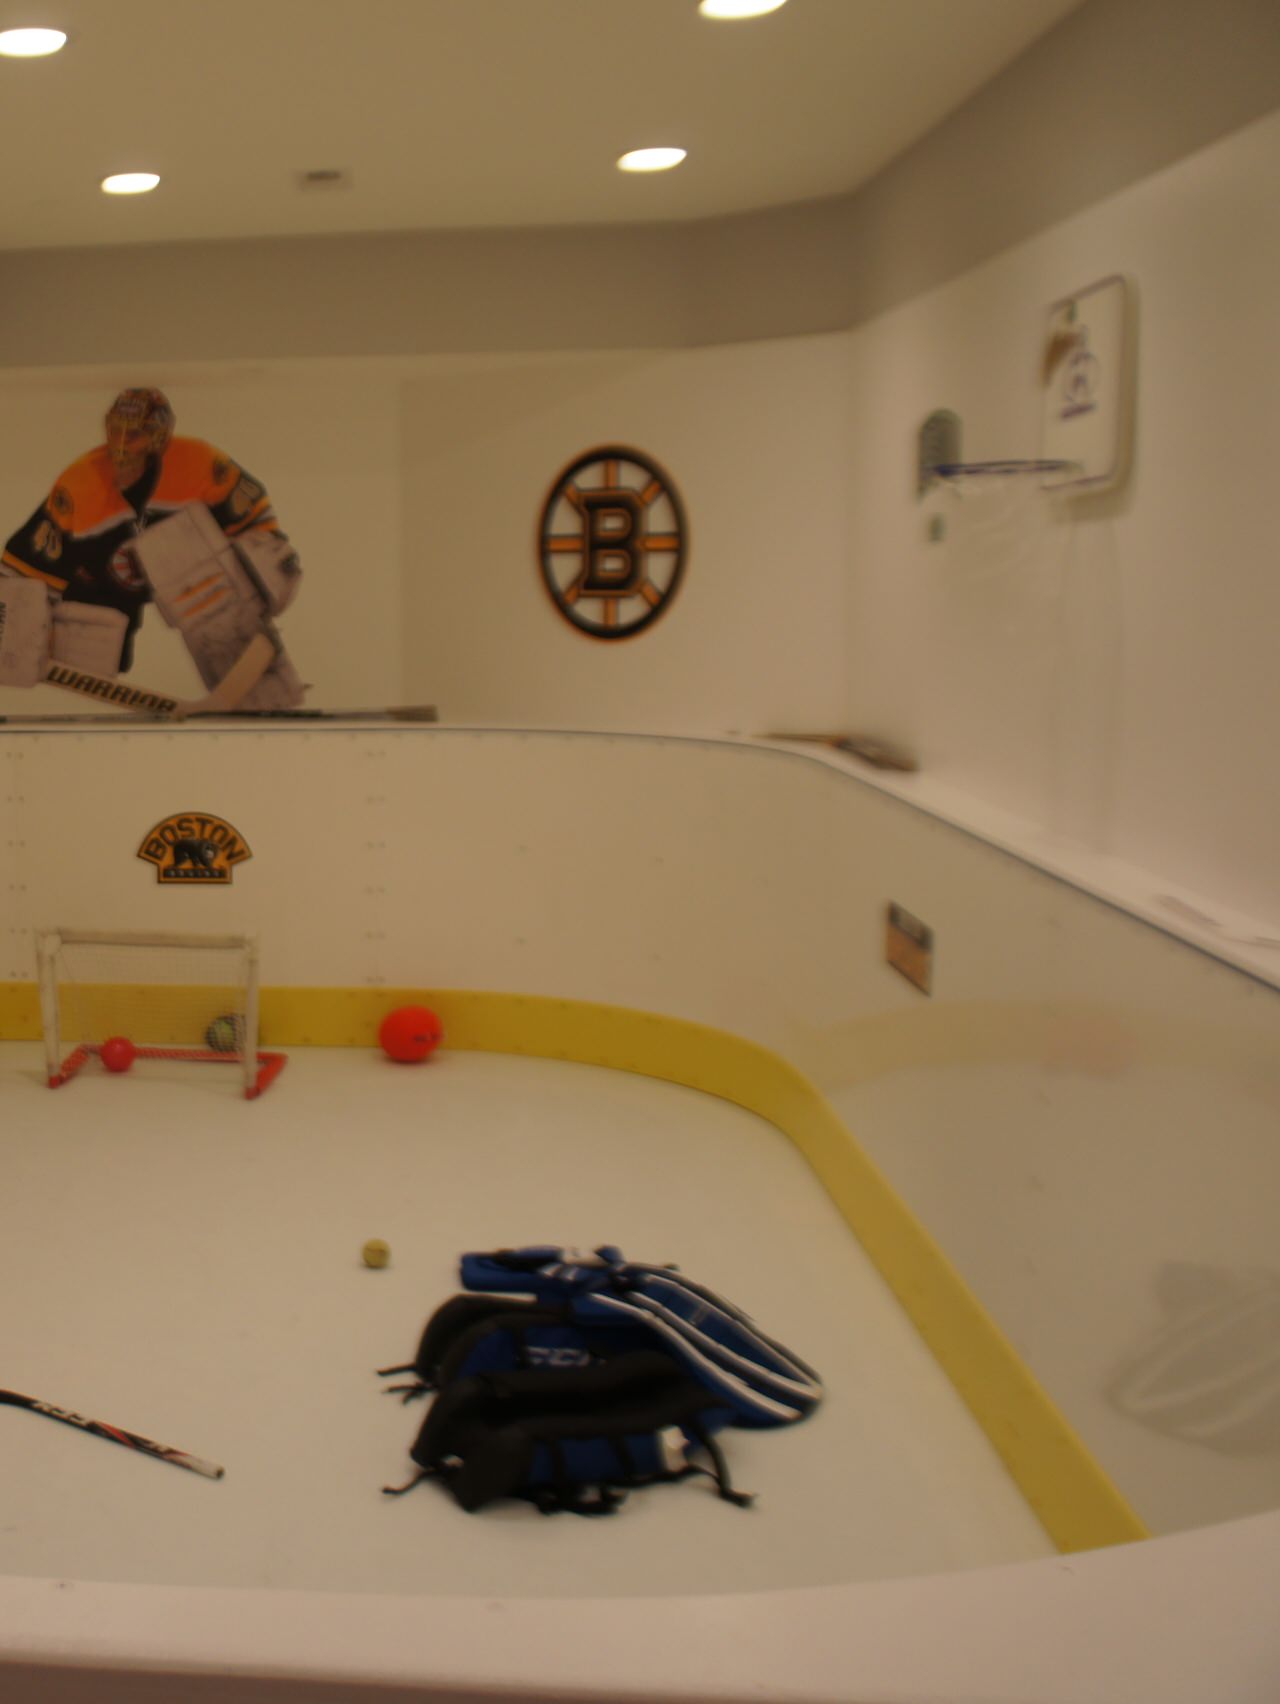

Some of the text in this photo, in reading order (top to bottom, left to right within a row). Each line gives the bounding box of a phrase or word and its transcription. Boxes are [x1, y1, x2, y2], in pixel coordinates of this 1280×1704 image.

[33, 519, 63, 560] 40
[580, 489, 645, 597] B
[46, 665, 179, 712] WARRIOR
[143, 816, 247, 861] BOSTON
